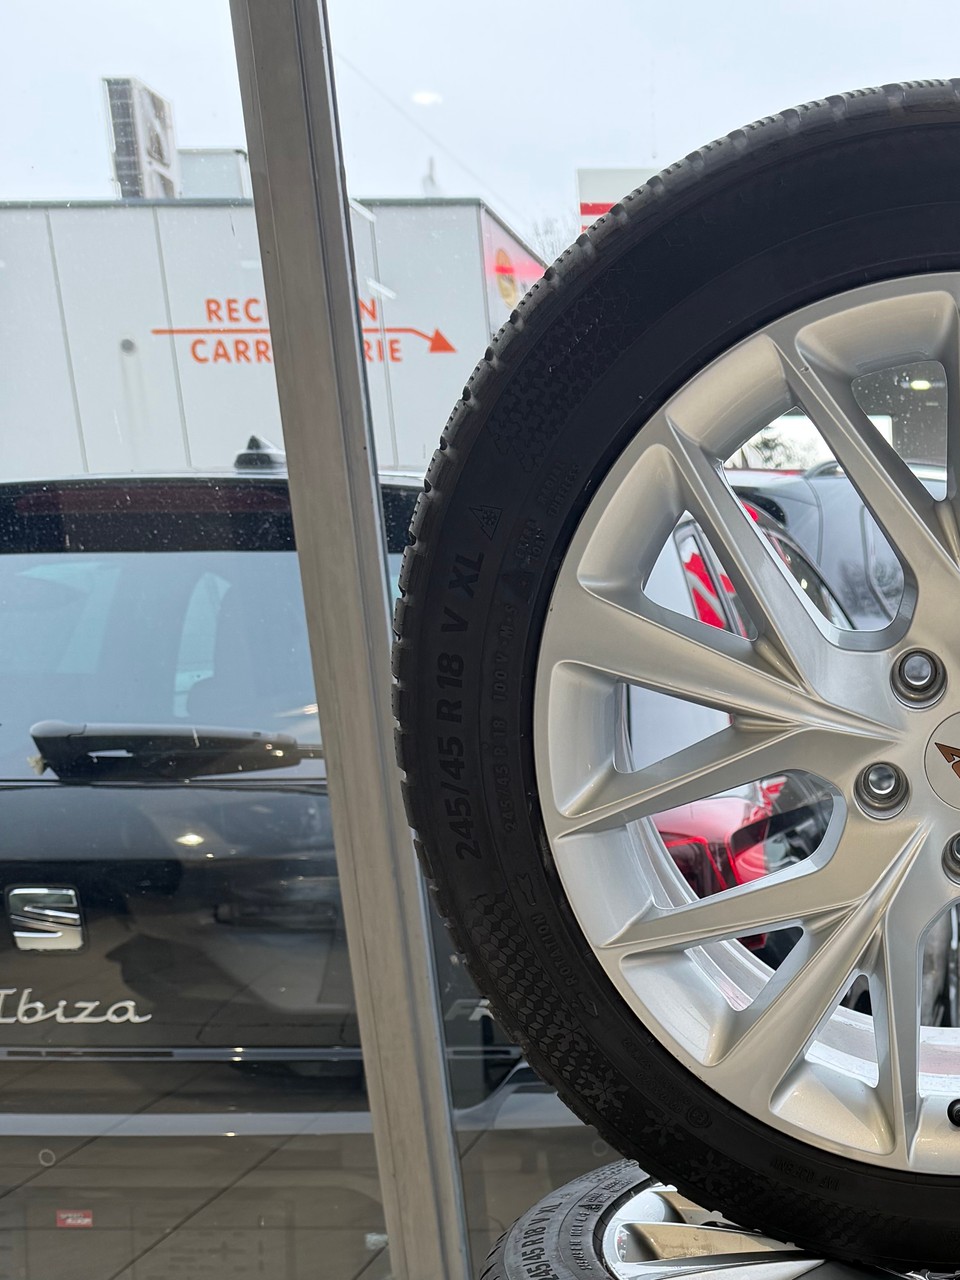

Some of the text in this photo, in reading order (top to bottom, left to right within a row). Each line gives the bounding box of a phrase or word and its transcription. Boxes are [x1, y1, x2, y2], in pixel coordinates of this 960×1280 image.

[436, 549, 485, 862] 245/45 R 18 V XL
[0, 987, 152, 1024] Ibiza
[535, 1201, 563, 1217] XL
[528, 1214, 551, 1228] V
[524, 1226, 547, 1238] 18
[523, 1238, 544, 1249] R
